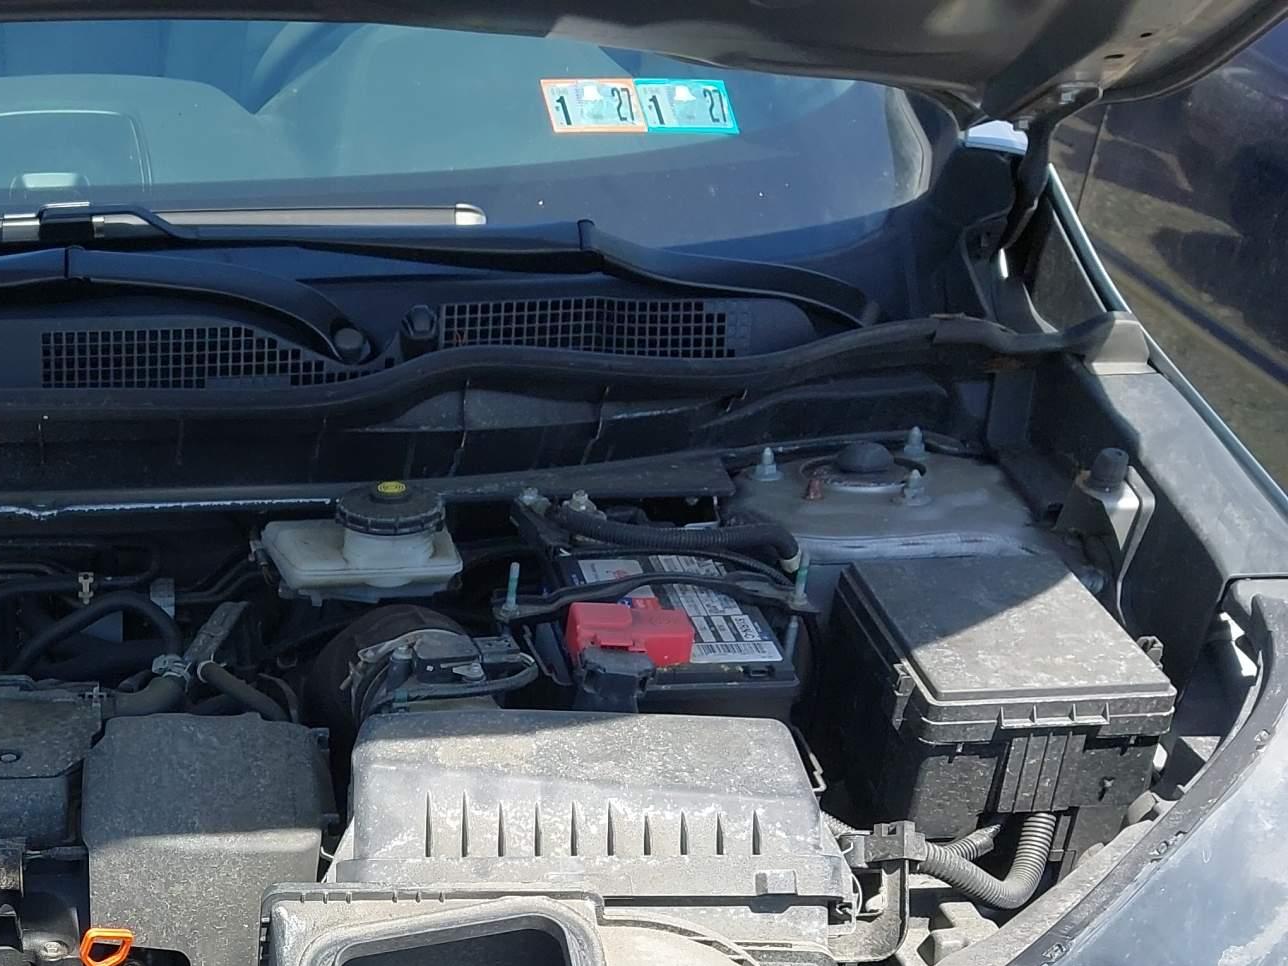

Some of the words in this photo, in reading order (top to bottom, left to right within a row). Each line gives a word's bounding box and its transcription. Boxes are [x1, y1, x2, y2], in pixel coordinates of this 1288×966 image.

[556, 96, 572, 125] 1
[612, 87, 635, 122] 27
[649, 95, 665, 125] 1
[703, 88, 727, 123] 27
